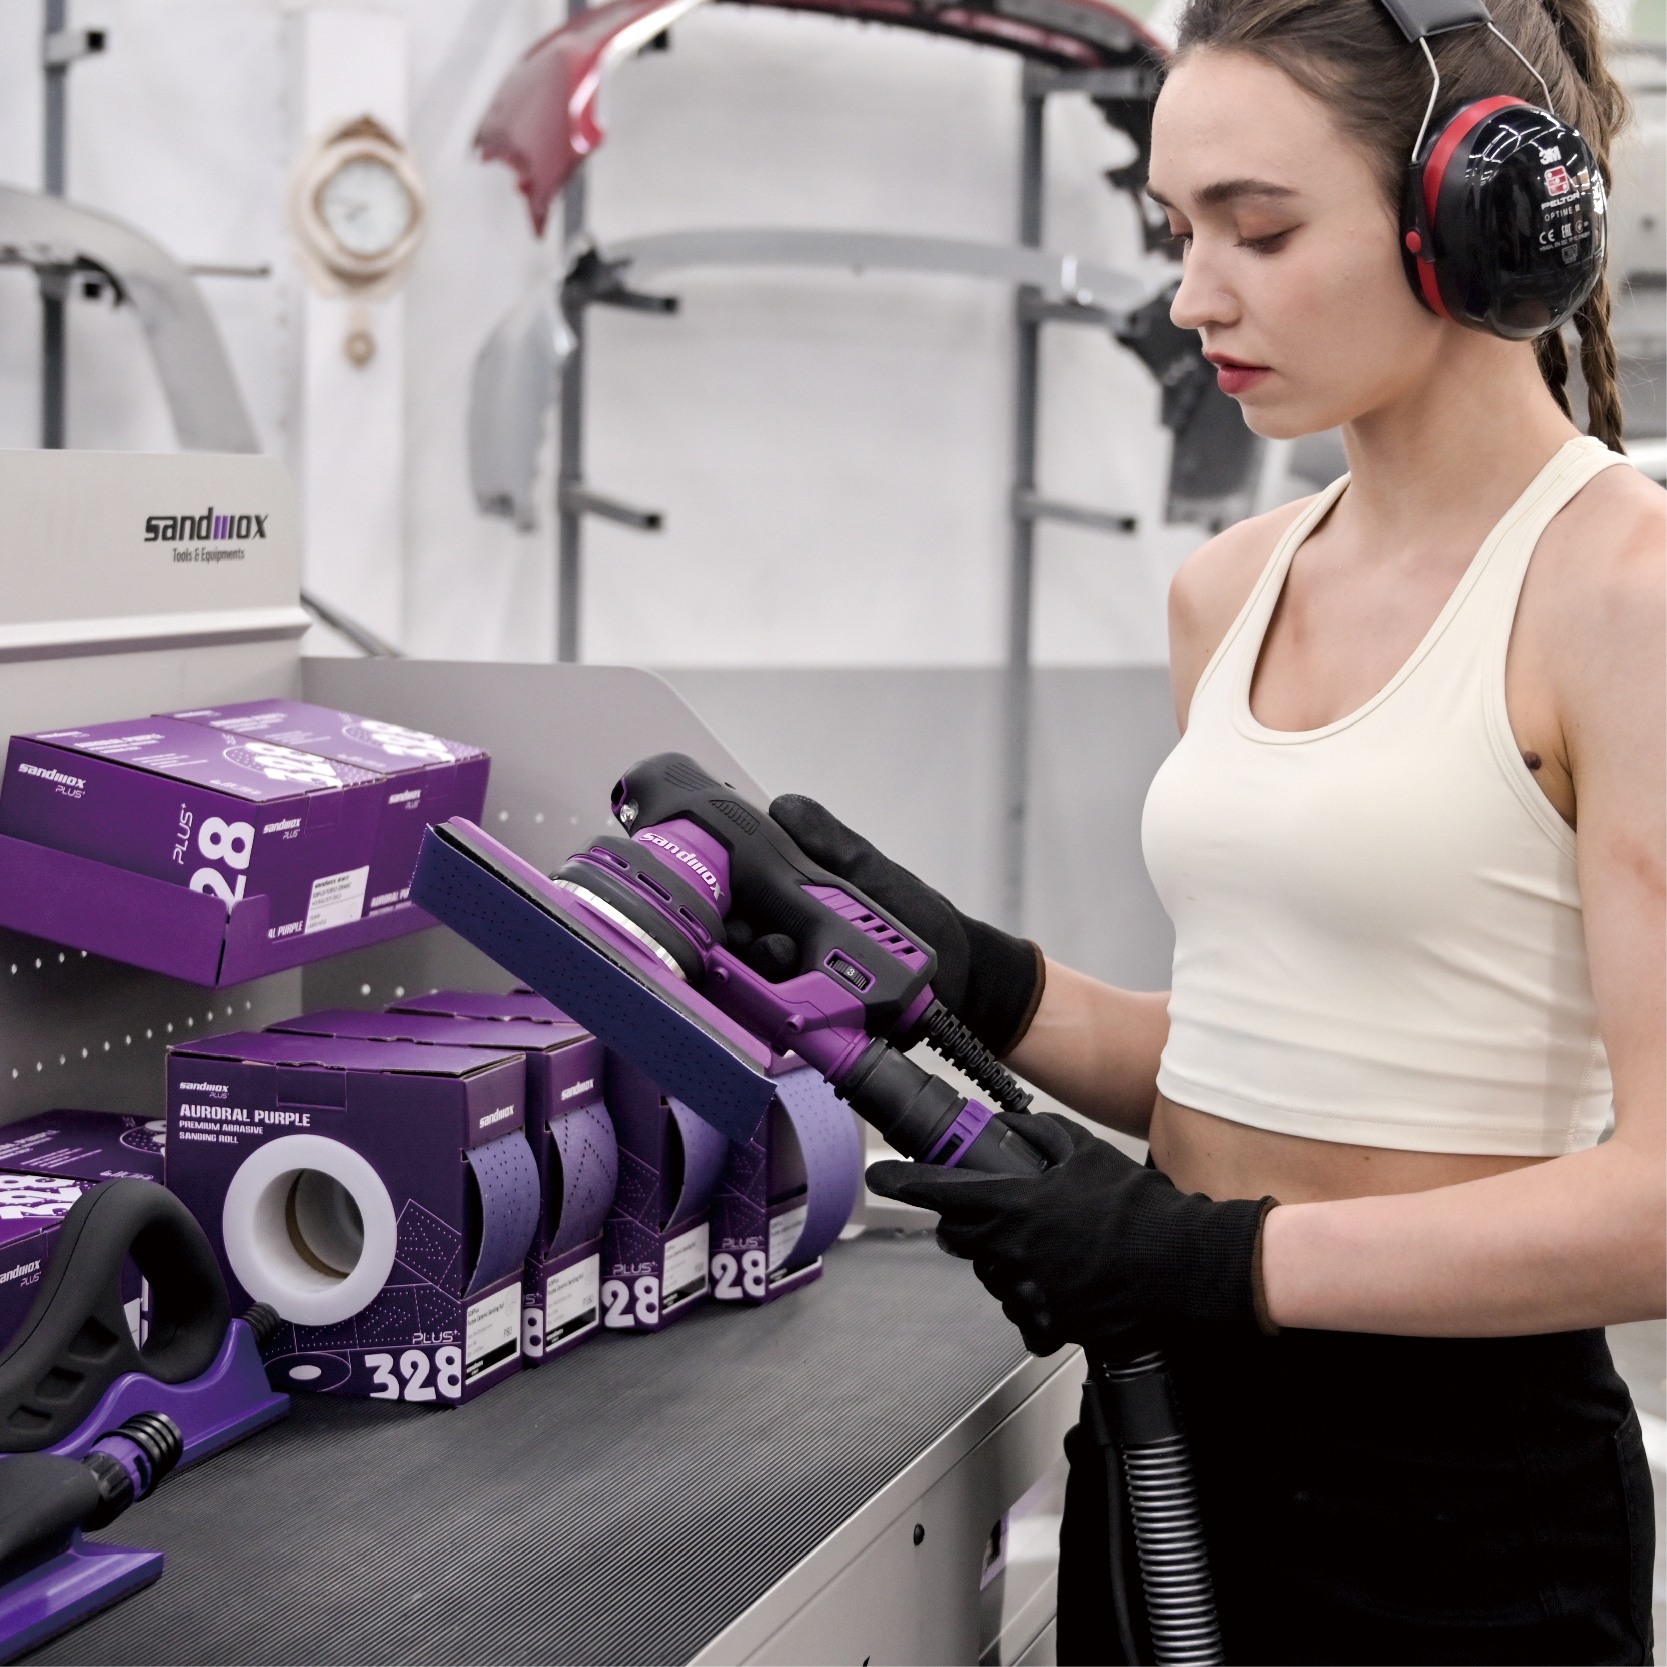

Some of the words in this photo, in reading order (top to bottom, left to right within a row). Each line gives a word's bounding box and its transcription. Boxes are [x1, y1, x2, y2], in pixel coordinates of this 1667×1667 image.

[1539, 146, 1562, 165] 3M
[1541, 192, 1580, 210] PELTOR
[1544, 206, 1573, 222] OPTIME
[1539, 229, 1555, 244] CE
[173, 548, 192, 562] Tools
[194, 547, 200, 561] &
[201, 546, 245, 563] Equipments
[189, 817, 256, 914] 28
[278, 921, 303, 937] PURPLE
[847, 968, 856, 976] 3
[180, 1103, 251, 1122] AURORAL
[254, 1109, 311, 1127] PURPLE
[179, 1120, 220, 1131] PREMIUM
[222, 1123, 264, 1135] ABRASIVE
[179, 1131, 217, 1142] SANDING
[218, 1134, 239, 1144] ROLL
[711, 1250, 767, 1299] 28
[601, 1275, 659, 1328] 28
[364, 1345, 462, 1402] 328
